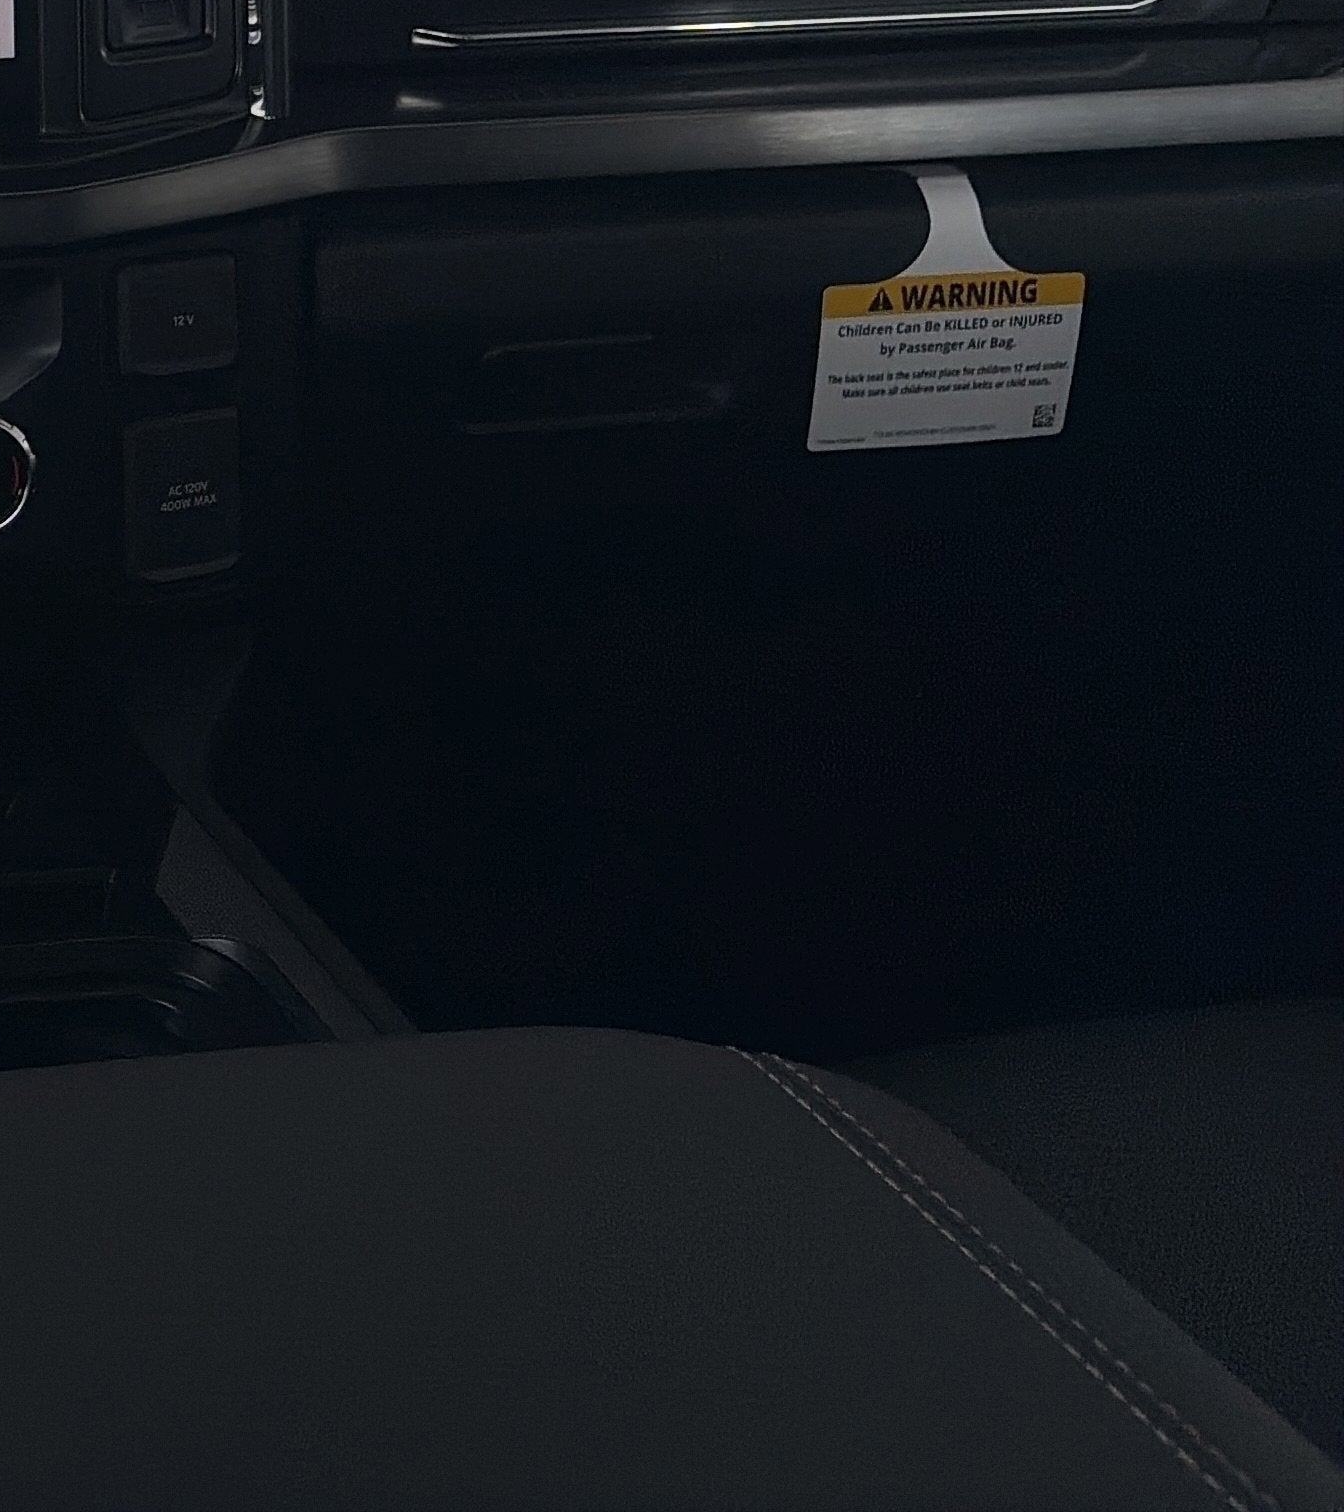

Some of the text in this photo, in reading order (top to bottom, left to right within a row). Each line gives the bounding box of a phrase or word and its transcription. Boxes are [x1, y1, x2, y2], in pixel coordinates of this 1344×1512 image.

[901, 277, 1038, 311] WARNING
[173, 314, 194, 327] 12 V
[838, 313, 1063, 338] Children Can Be KILLED or INJURED
[880, 341, 895, 356] by
[898, 339, 964, 355] Passenger
[967, 337, 985, 350] Air
[896, 370, 910, 380] the
[938, 368, 961, 380] place
[977, 364, 1011, 374] children
[1025, 362, 1041, 372] and
[900, 384, 934, 395] children
[168, 485, 182, 497] AC
[193, 494, 217, 507] MAX
